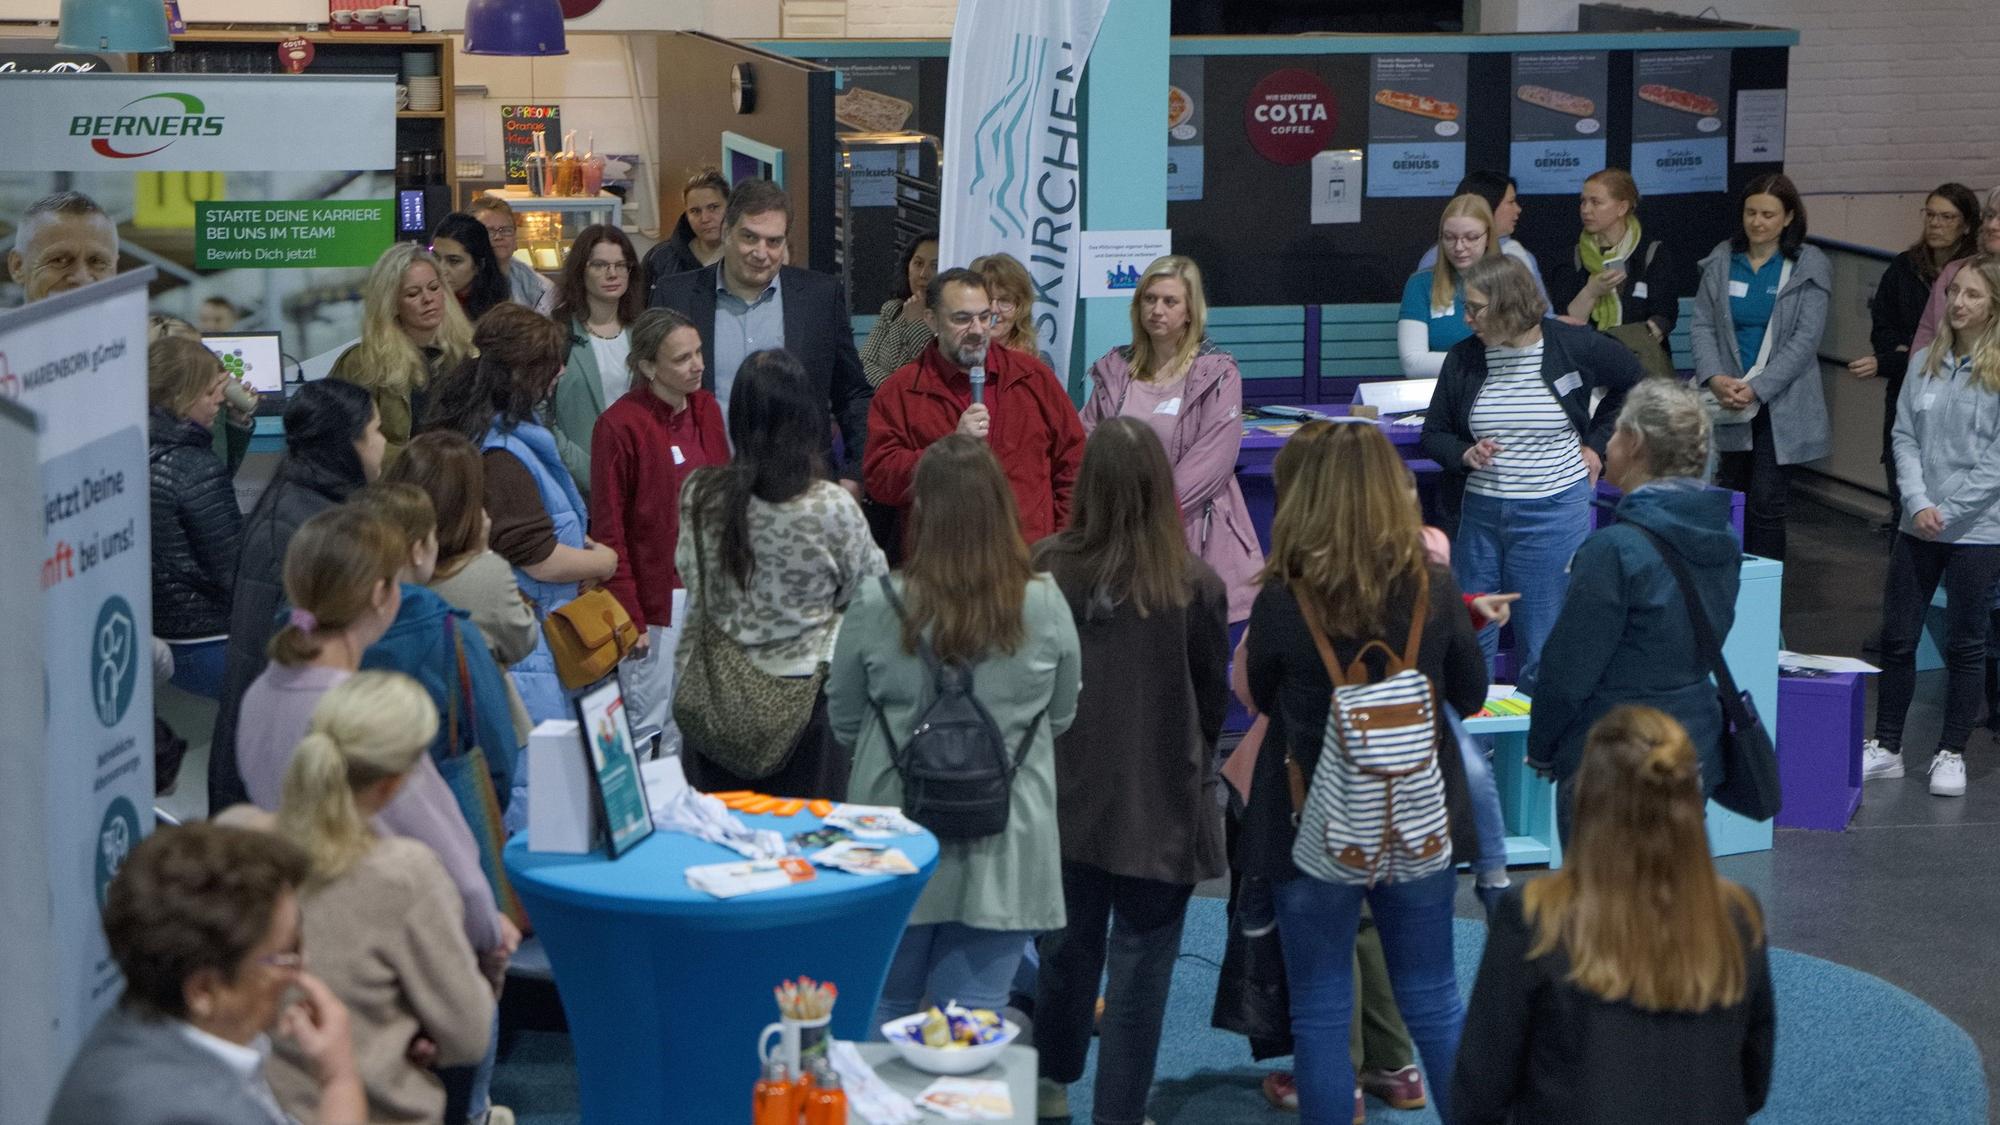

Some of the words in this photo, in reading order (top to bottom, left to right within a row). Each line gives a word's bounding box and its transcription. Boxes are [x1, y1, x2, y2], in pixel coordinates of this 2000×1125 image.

[1280, 93, 1317, 101] SERVIEREN
[1254, 103, 1328, 124] COSTA
[69, 116, 225, 136] BERNERS
[1393, 160, 1440, 170] GENUSS
[1535, 158, 1580, 168] GENUSS
[1656, 156, 1703, 167] GENUSS
[206, 209, 261, 223] STARTE
[265, 209, 309, 223] DEINE
[313, 208, 381, 222] KARRIERE
[206, 227, 229, 240] BEI
[234, 227, 266, 240] UNS
[270, 226, 287, 240] IM
[291, 225, 336, 240] TEAM!
[207, 248, 251, 260] Bewirb
[255, 248, 284, 260] Dich
[285, 247, 316, 262] jetzt!
[83, 468, 124, 509] Deine
[79, 531, 100, 573] bei
[103, 517, 135, 562] uns!
